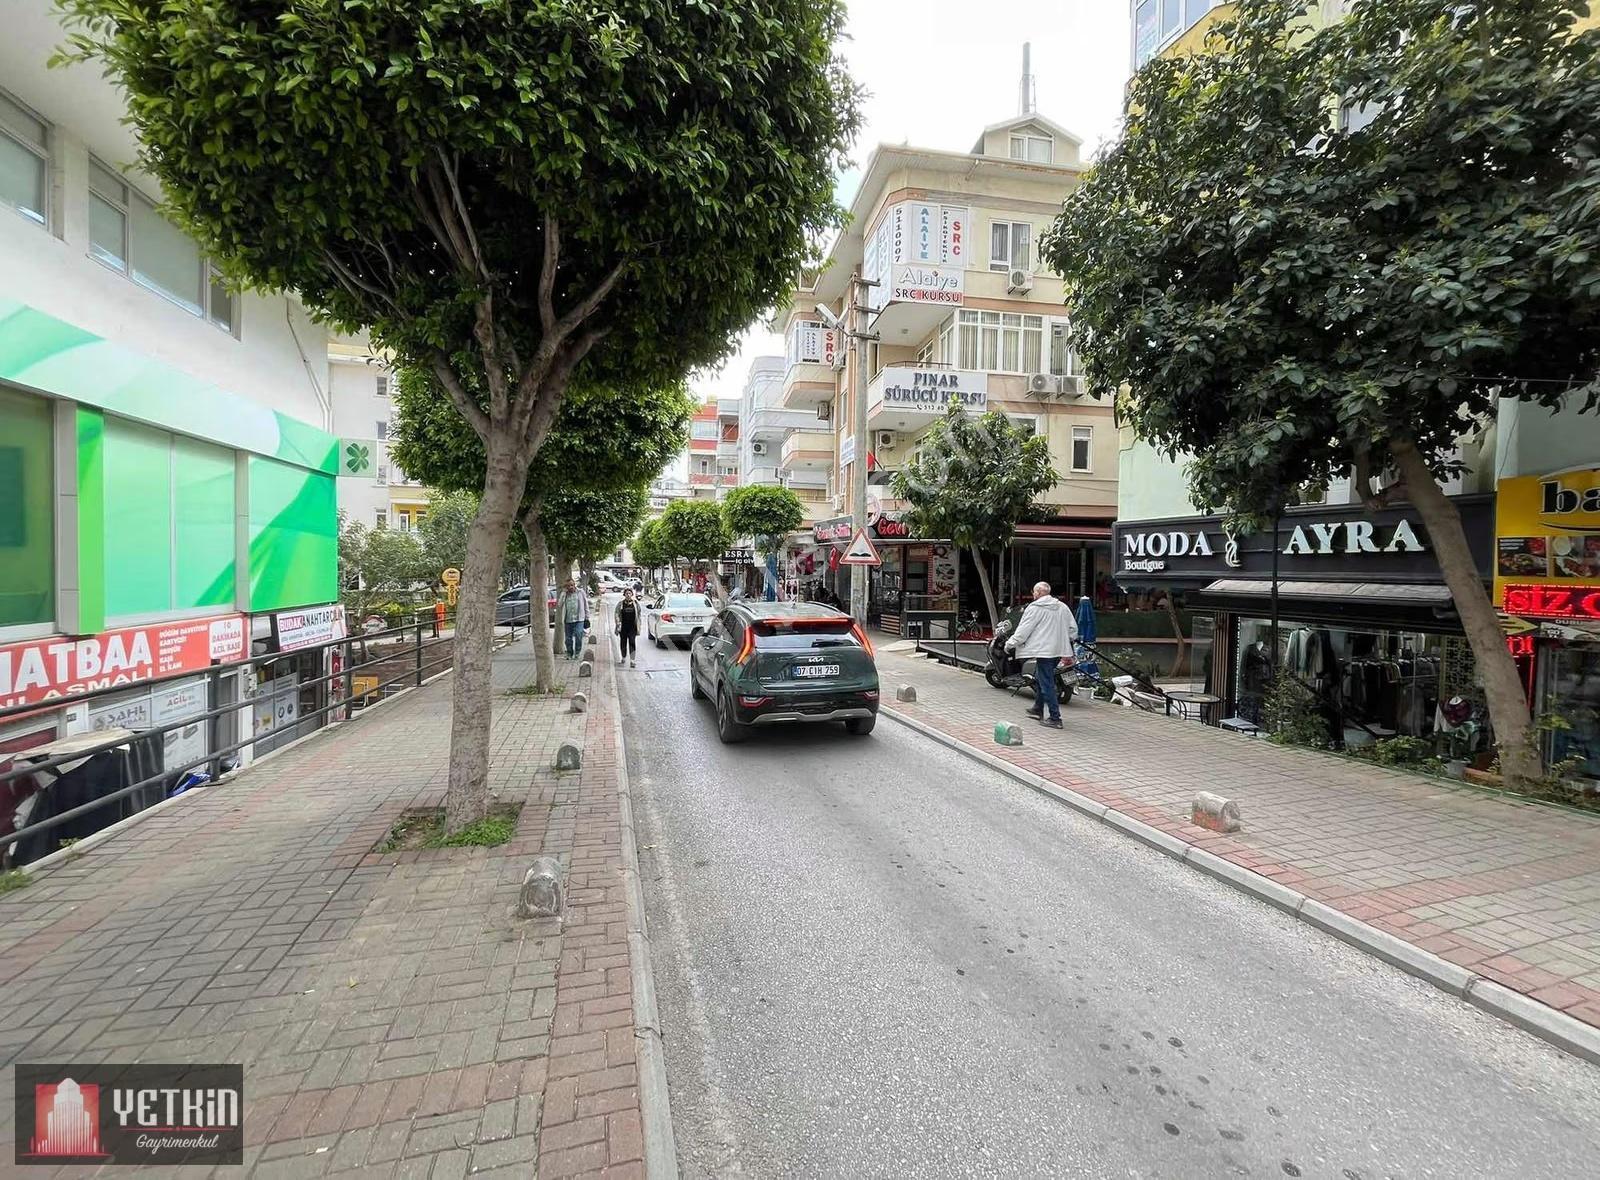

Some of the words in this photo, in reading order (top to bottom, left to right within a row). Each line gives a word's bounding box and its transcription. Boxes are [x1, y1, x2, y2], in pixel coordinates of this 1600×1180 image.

[952, 221, 961, 256] SRC
[899, 267, 958, 291] Alaiye
[895, 288, 916, 299] SRC
[922, 289, 959, 302] KURSU
[826, 332, 834, 362] SRC
[913, 372, 958, 388] PINAR
[884, 384, 938, 403] SÜRÜCÜ
[1123, 530, 1212, 557] MODA
[1282, 519, 1425, 554] AYRA
